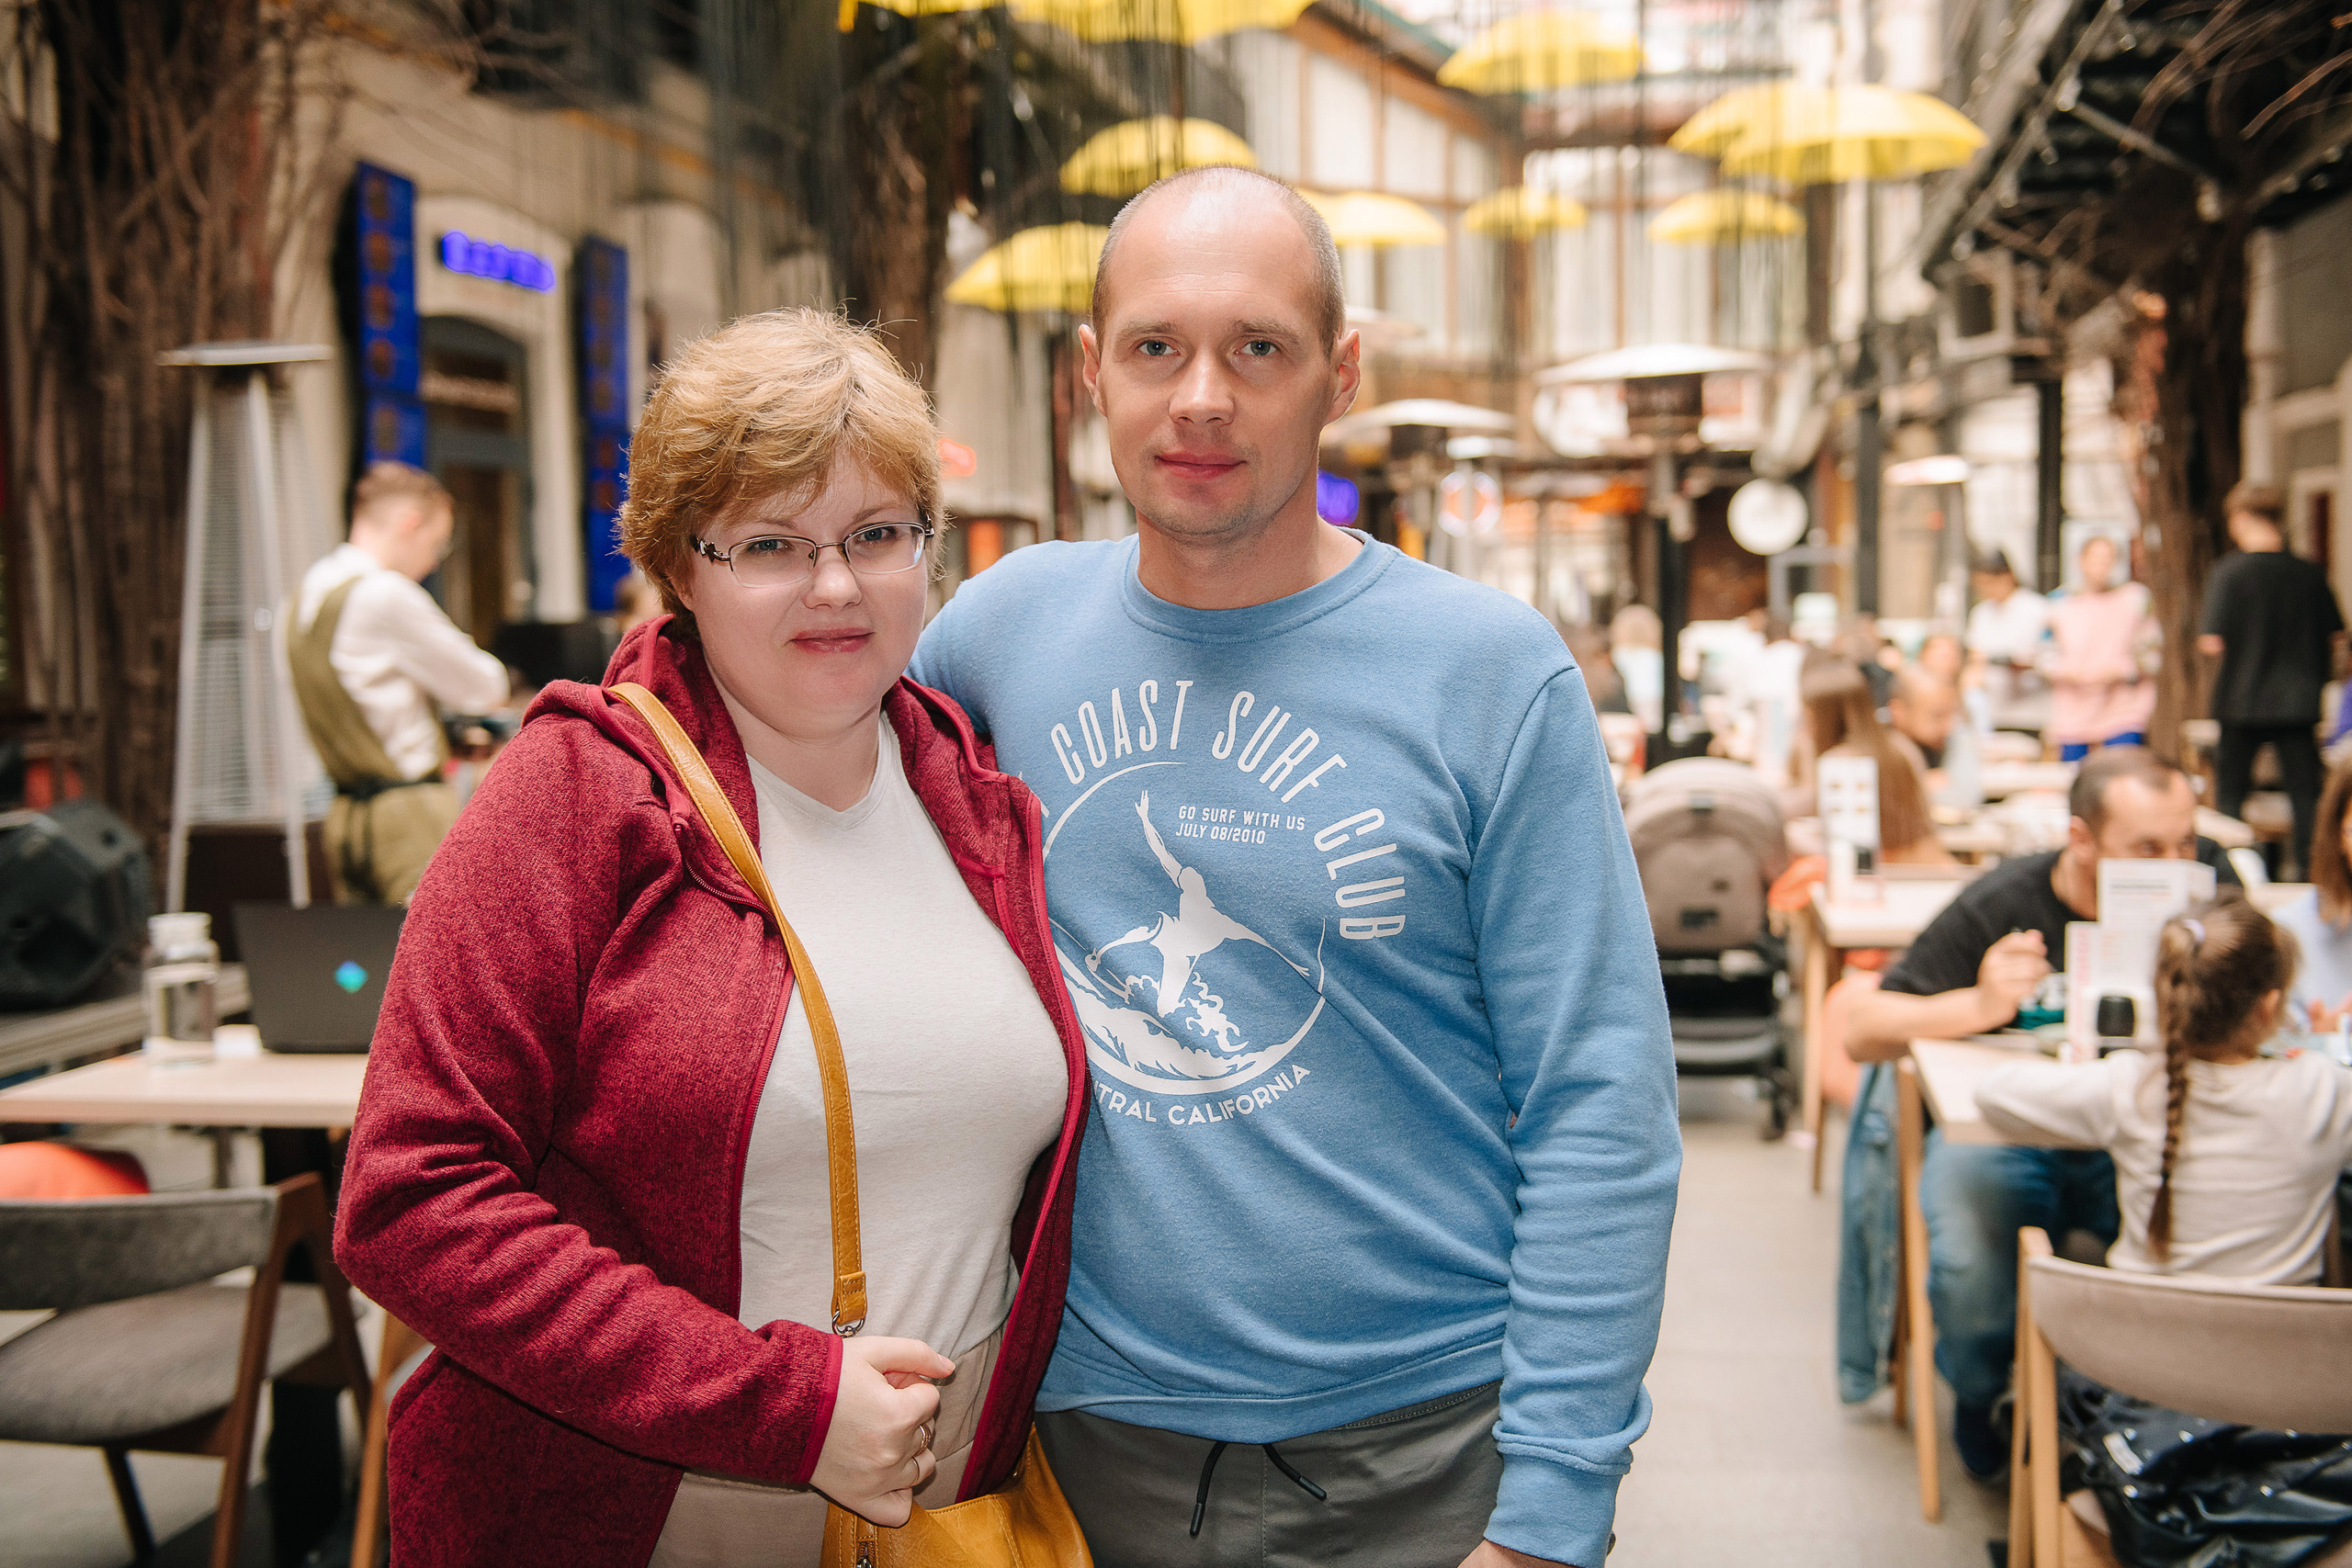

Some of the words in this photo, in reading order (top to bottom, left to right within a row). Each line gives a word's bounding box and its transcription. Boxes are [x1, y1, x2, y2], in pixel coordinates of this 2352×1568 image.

[1051, 679, 1194, 786] COAST
[1211, 690, 1348, 804] SURF
[1314, 807, 1407, 941] CLUB
[1178, 805, 1196, 820] GO
[1201, 807, 1237, 824] SURF
[1243, 810, 1280, 829] WITH
[1286, 815, 1306, 831] US
[1175, 822, 1208, 839] JULY
[1210, 826, 1266, 845] 08/2010
[1168, 1064, 1311, 1126] CALIFORNIA
